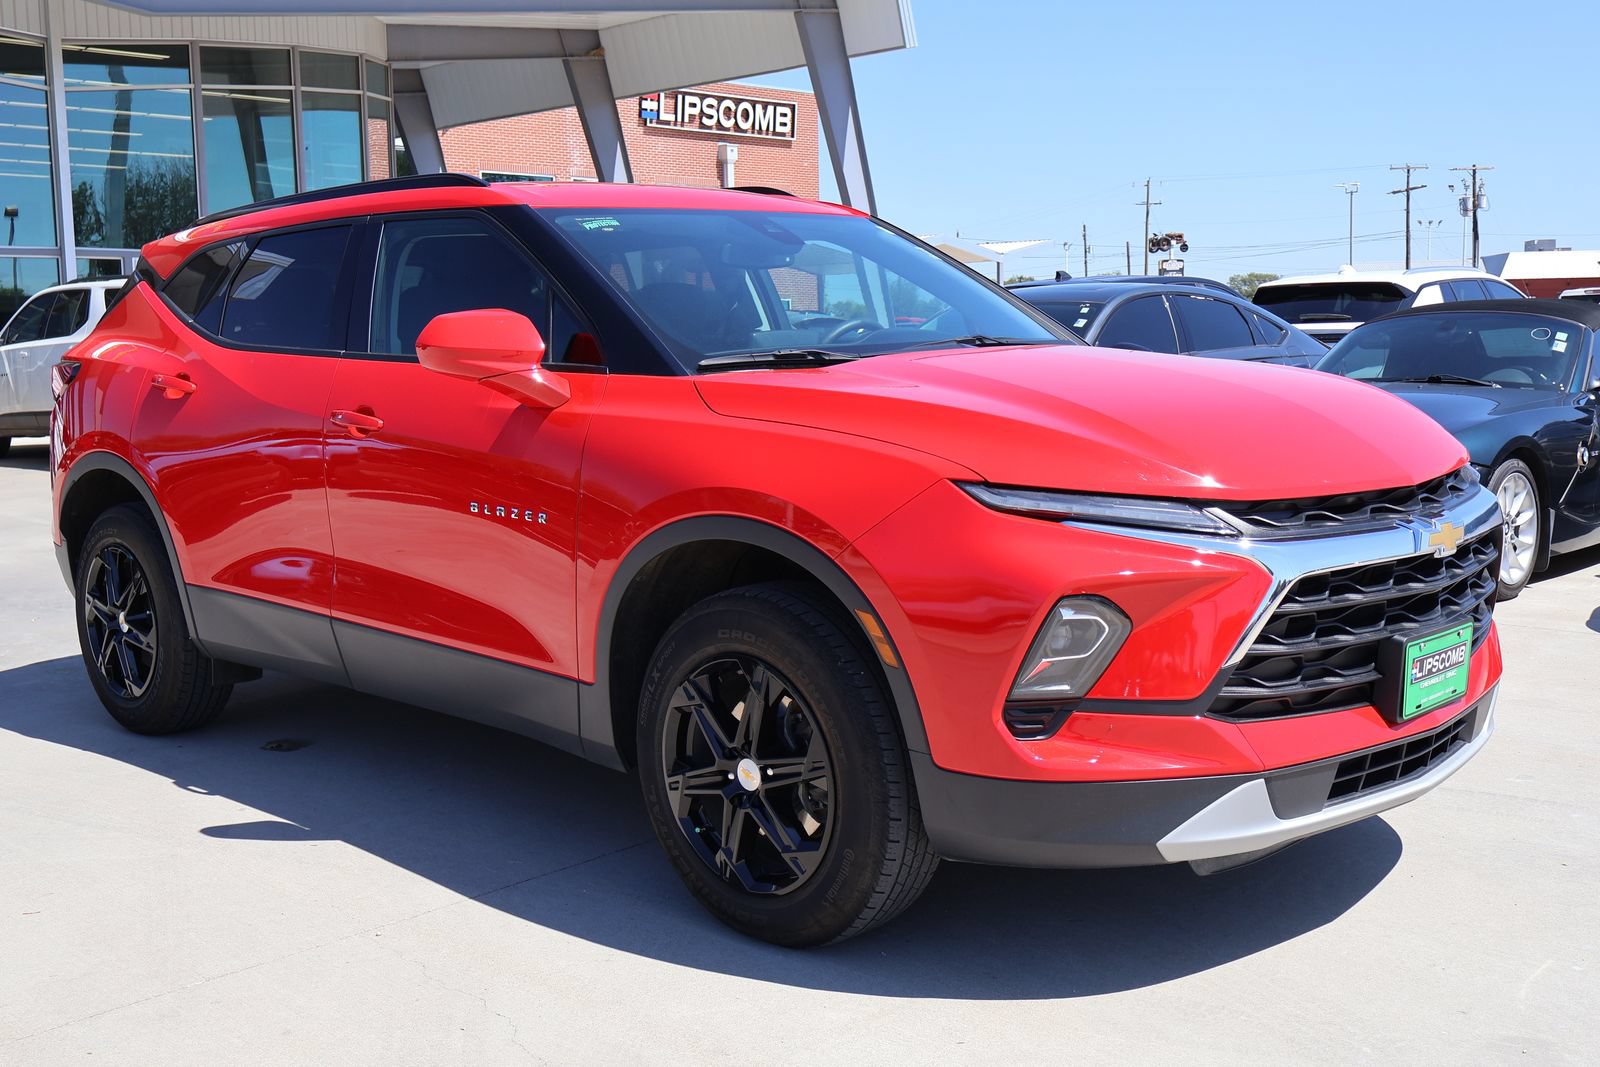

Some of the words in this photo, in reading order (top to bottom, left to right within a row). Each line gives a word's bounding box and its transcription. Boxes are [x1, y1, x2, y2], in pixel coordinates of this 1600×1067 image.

[659, 92, 792, 133] LIPSCOMB
[469, 502, 547, 524] BLAZER
[1415, 645, 1466, 678] LIPSCOMB
[825, 848, 855, 903] Continental
